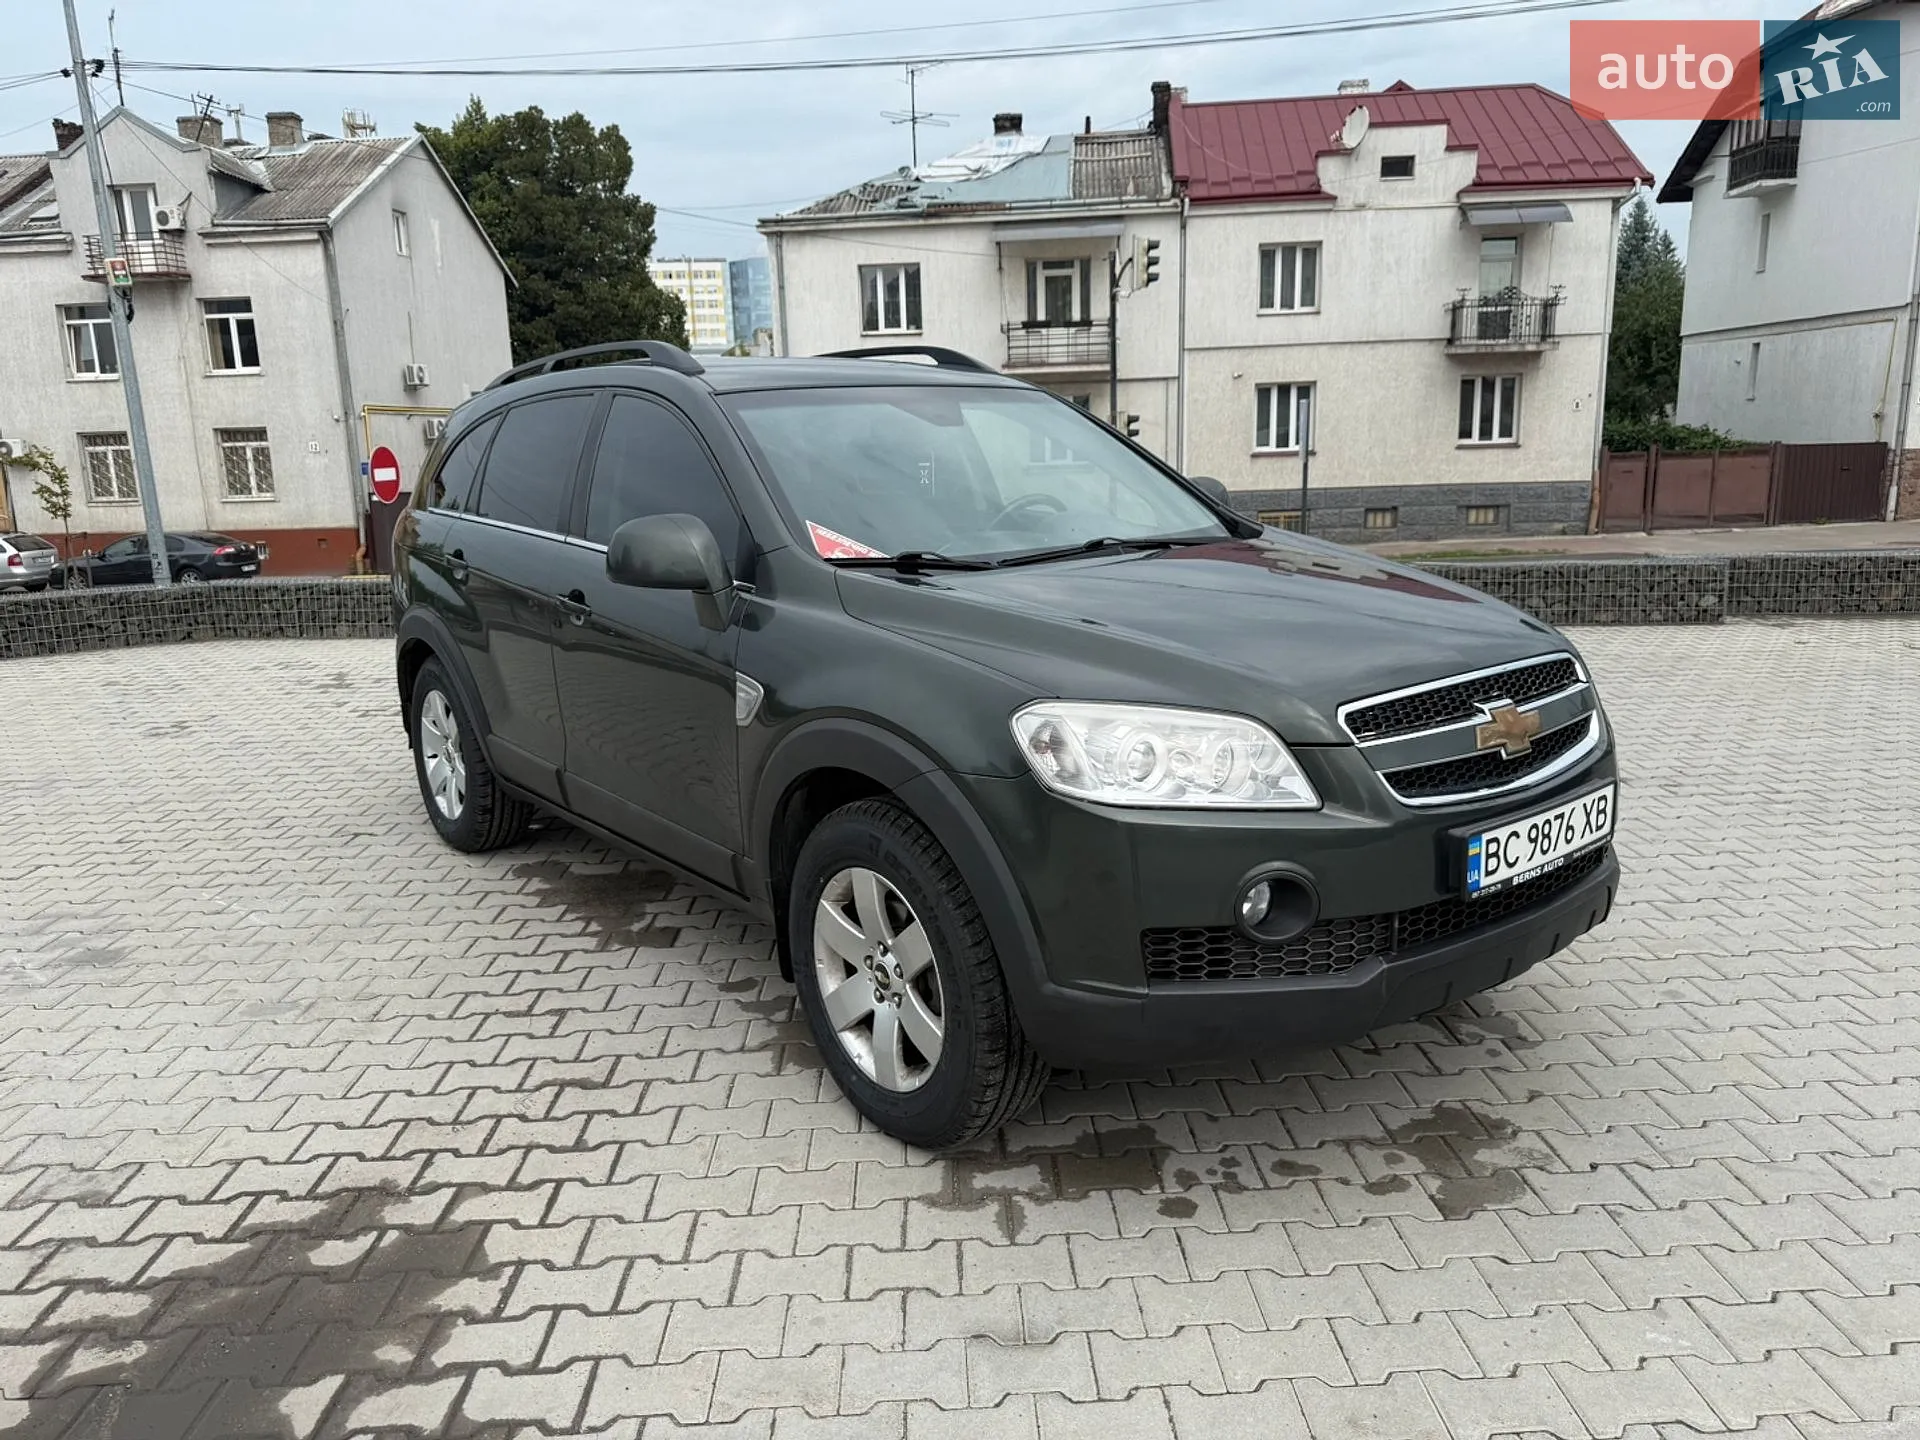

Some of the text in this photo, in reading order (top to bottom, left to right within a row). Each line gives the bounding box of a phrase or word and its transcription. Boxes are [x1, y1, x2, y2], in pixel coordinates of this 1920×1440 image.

[1484, 830, 1520, 877] BC
[1527, 807, 1576, 862] 9876
[1580, 794, 1608, 840] XB
[1467, 869, 1479, 883] UA
[1512, 857, 1564, 886] BERNS AUTO
